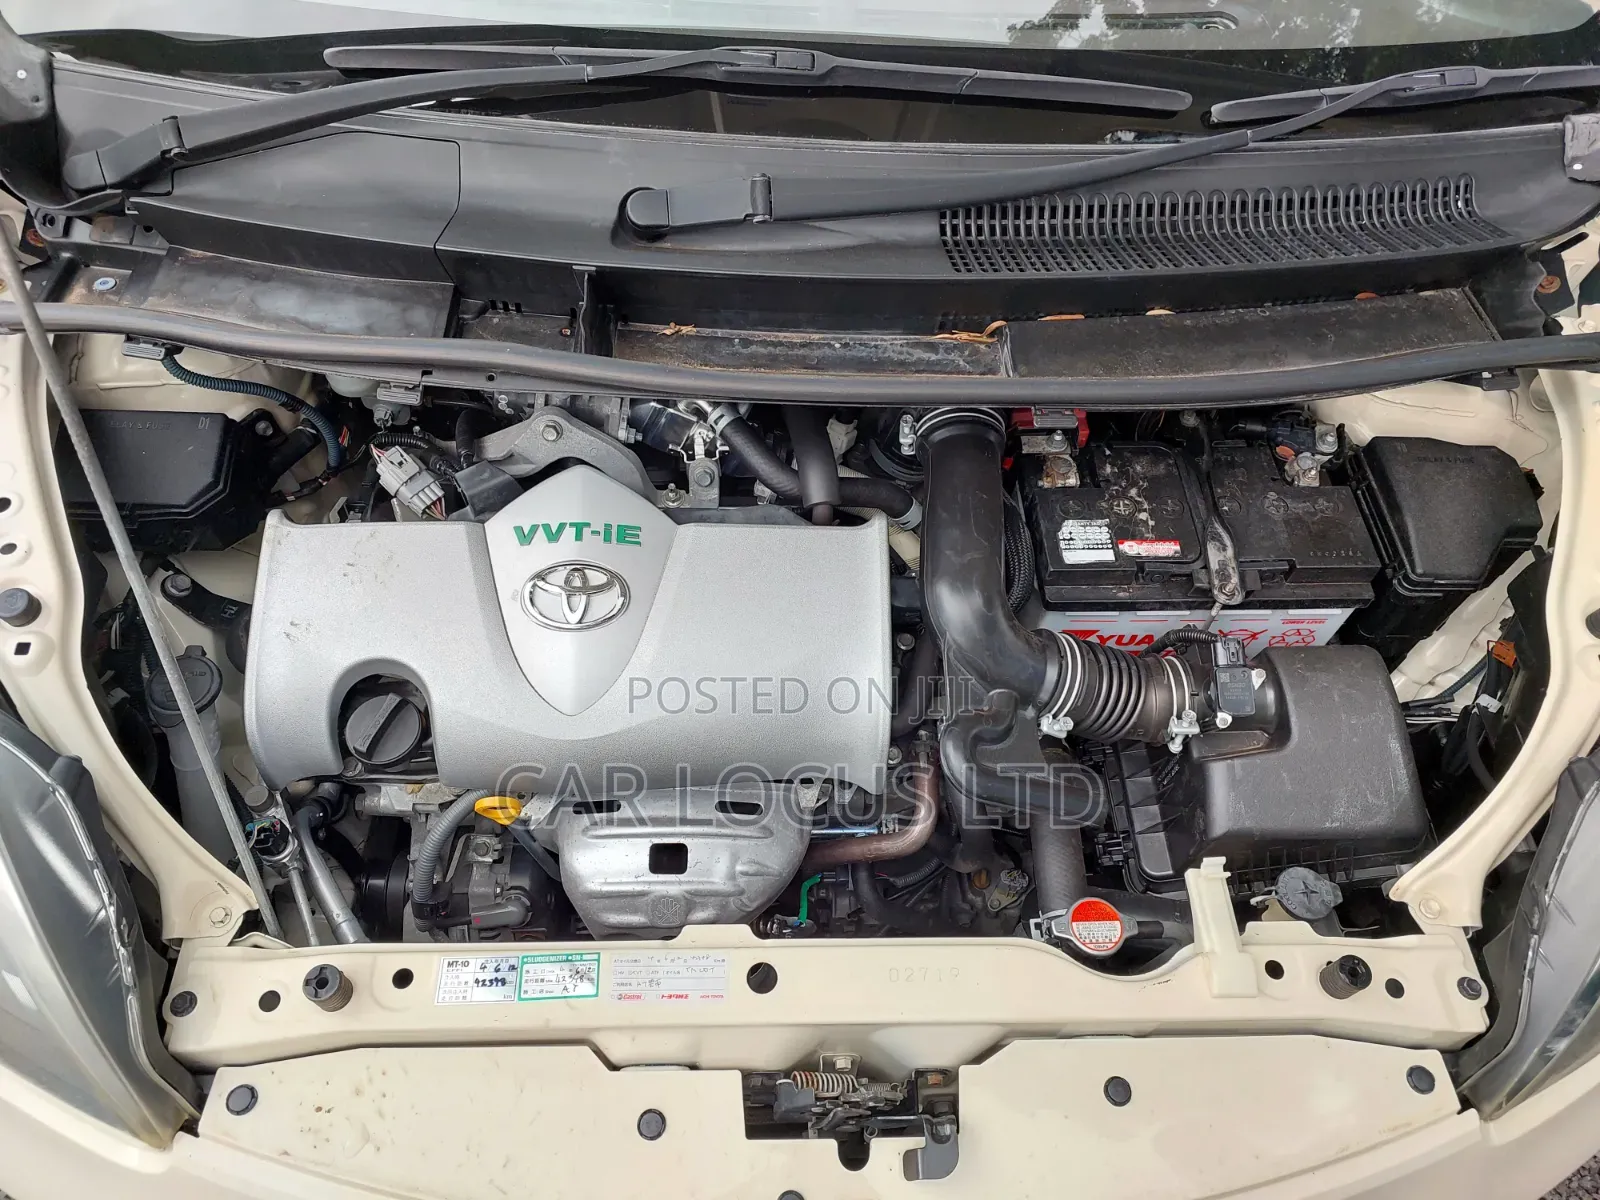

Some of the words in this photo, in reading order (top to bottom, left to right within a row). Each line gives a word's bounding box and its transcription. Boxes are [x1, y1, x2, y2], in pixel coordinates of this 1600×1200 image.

[513, 522, 642, 547] VVT-iE
[1096, 634, 1155, 647] YUA
[447, 960, 470, 968] MT-10
